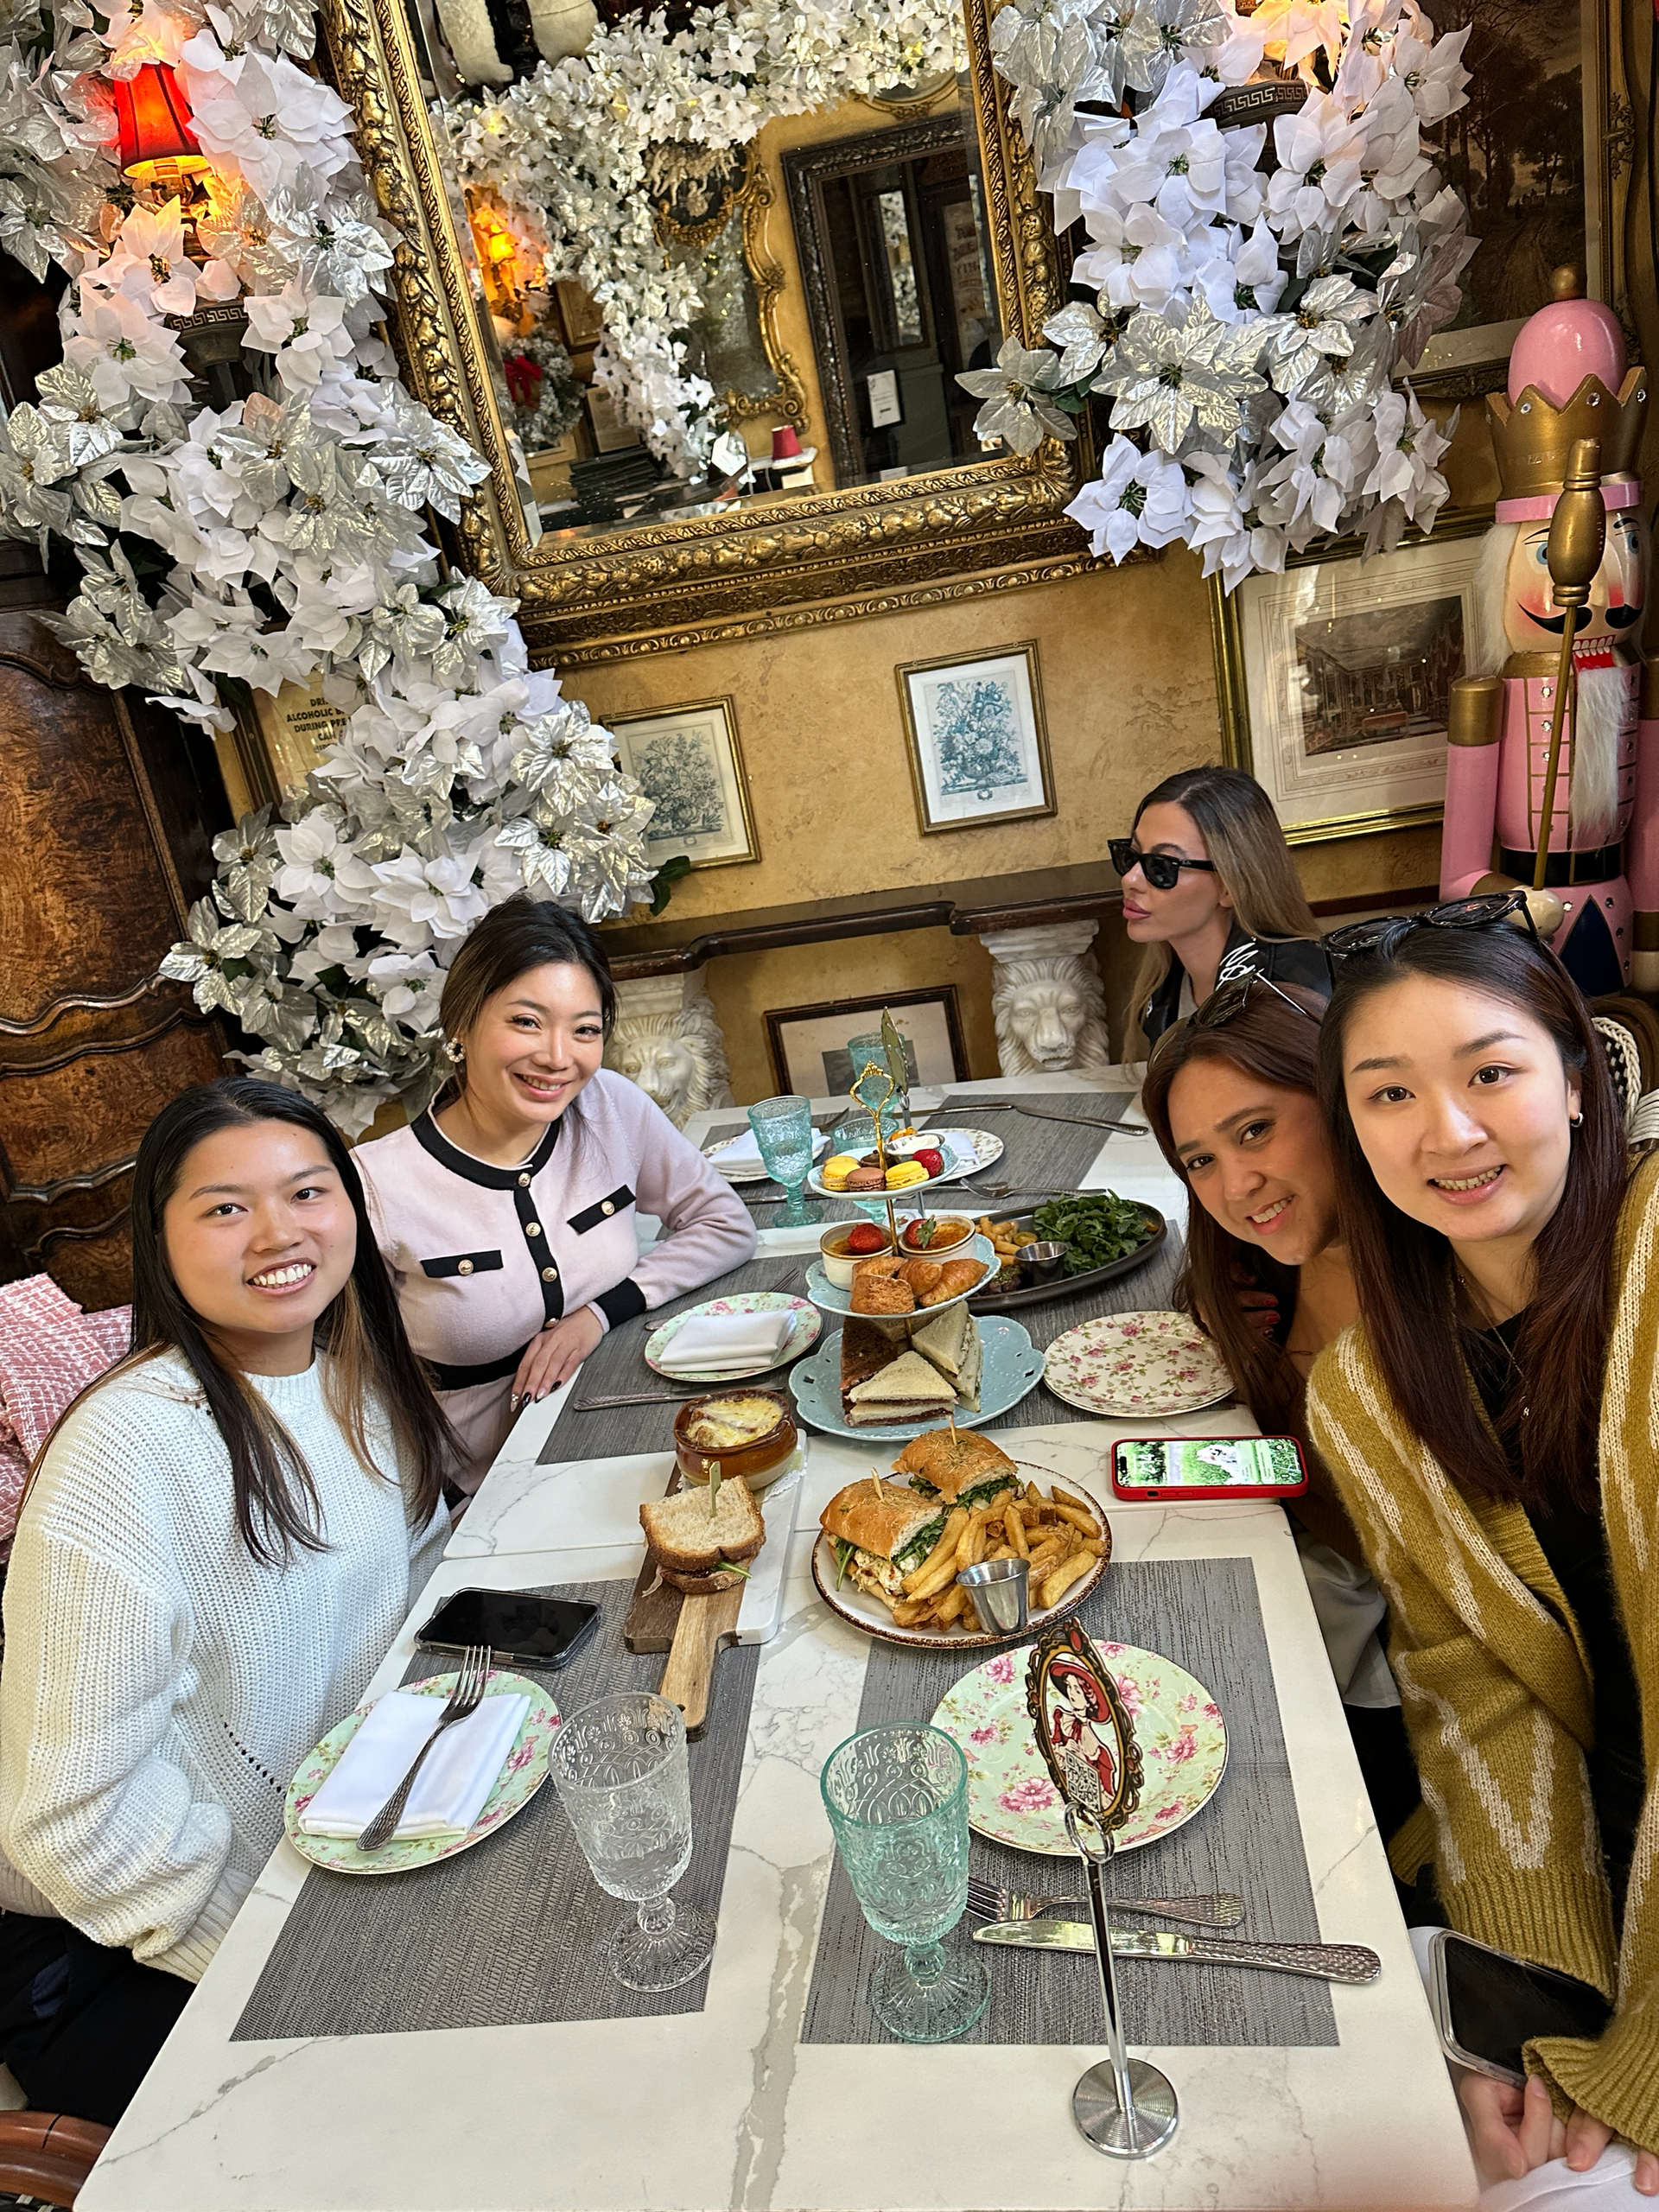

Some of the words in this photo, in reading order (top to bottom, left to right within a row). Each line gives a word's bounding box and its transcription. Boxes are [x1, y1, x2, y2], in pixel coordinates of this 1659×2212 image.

[287, 709, 333, 722] ALCOHOLIC
[294, 721, 327, 732] DURING
[1138, 1453, 1156, 1474] 2:14
